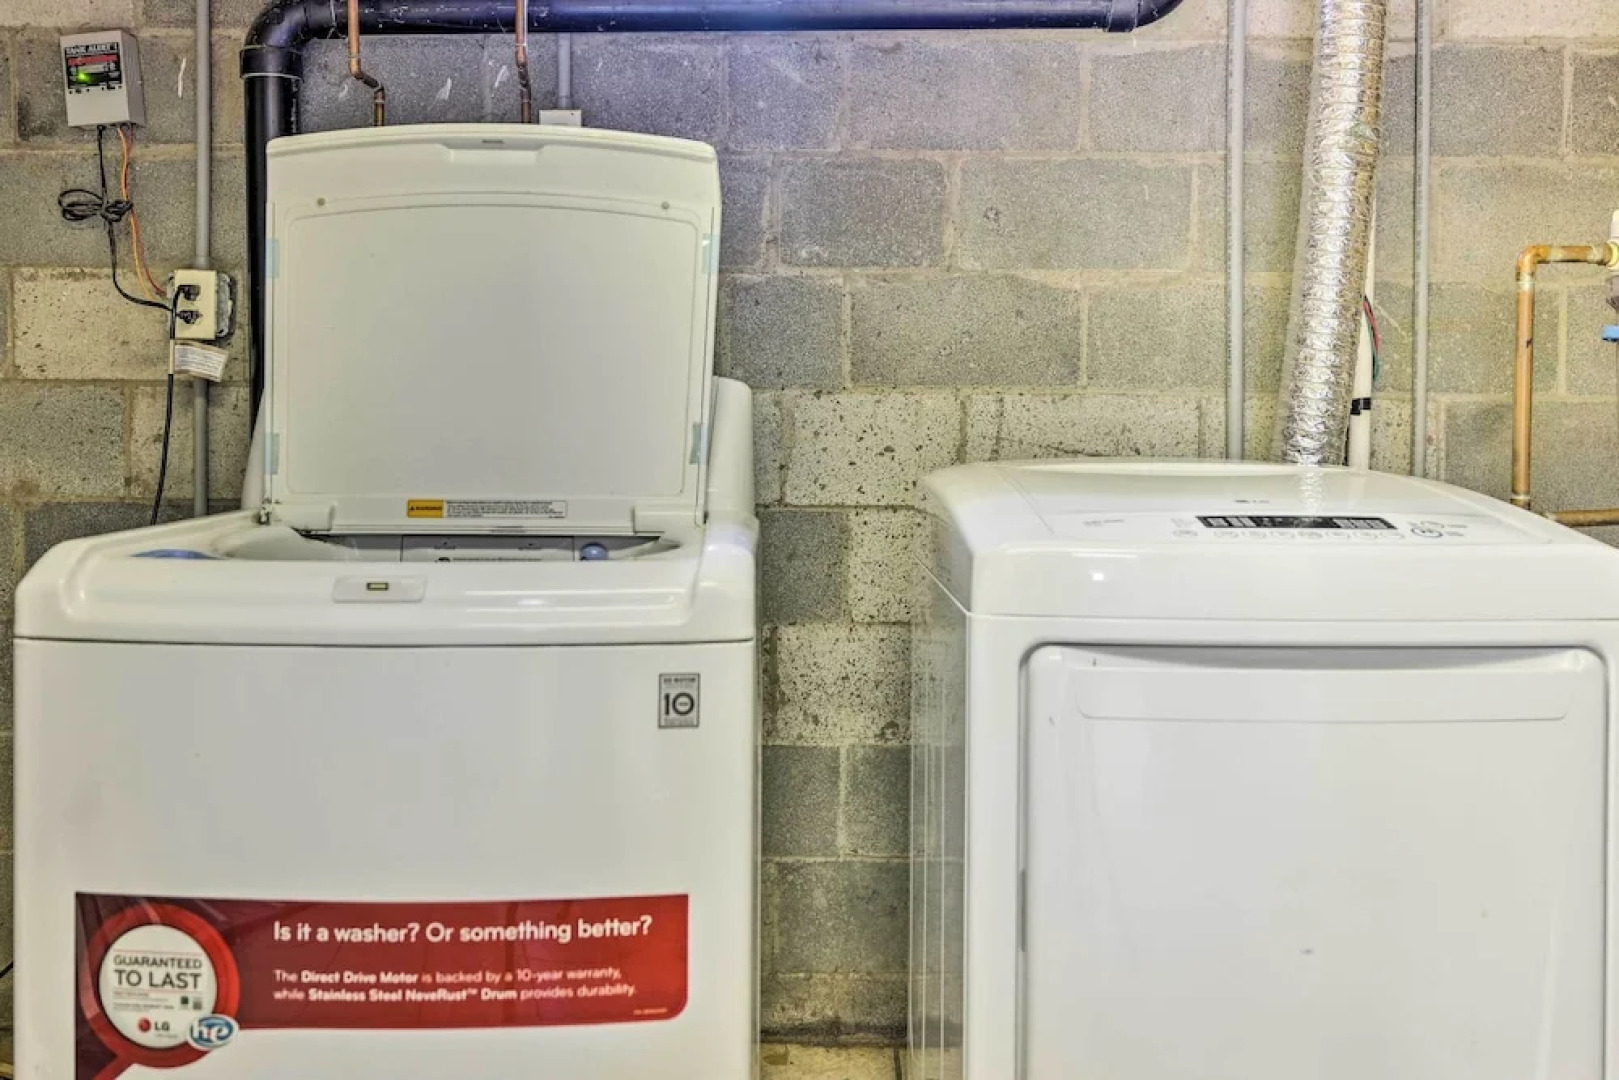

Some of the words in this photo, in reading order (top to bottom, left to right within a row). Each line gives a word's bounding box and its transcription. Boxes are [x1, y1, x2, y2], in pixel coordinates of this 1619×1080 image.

[664, 692, 695, 716] 10
[273, 921, 292, 941] Is
[296, 922, 312, 941] it
[316, 927, 330, 942] a
[333, 922, 420, 942] washer?
[425, 922, 454, 942] Or
[459, 918, 571, 944] something
[577, 914, 654, 936] better?
[113, 954, 202, 969] GUARANTEED
[114, 969, 142, 987] TO
[148, 971, 202, 990] LAST
[273, 969, 298, 982] The
[300, 969, 341, 983] Direct
[342, 970, 378, 983] Drive
[379, 970, 418, 984] Motor
[421, 971, 432, 983] is
[435, 970, 482, 983] backed
[485, 970, 501, 985] by
[504, 972, 513, 982] a
[516, 968, 563, 984] 10-year
[566, 966, 622, 980] warranty,
[273, 988, 305, 1000] while
[308, 988, 366, 1002] Stainless
[368, 988, 403, 1002] Steel
[480, 987, 517, 1001] Drum
[520, 987, 574, 1002] provides
[154, 1020, 171, 1031] LG
